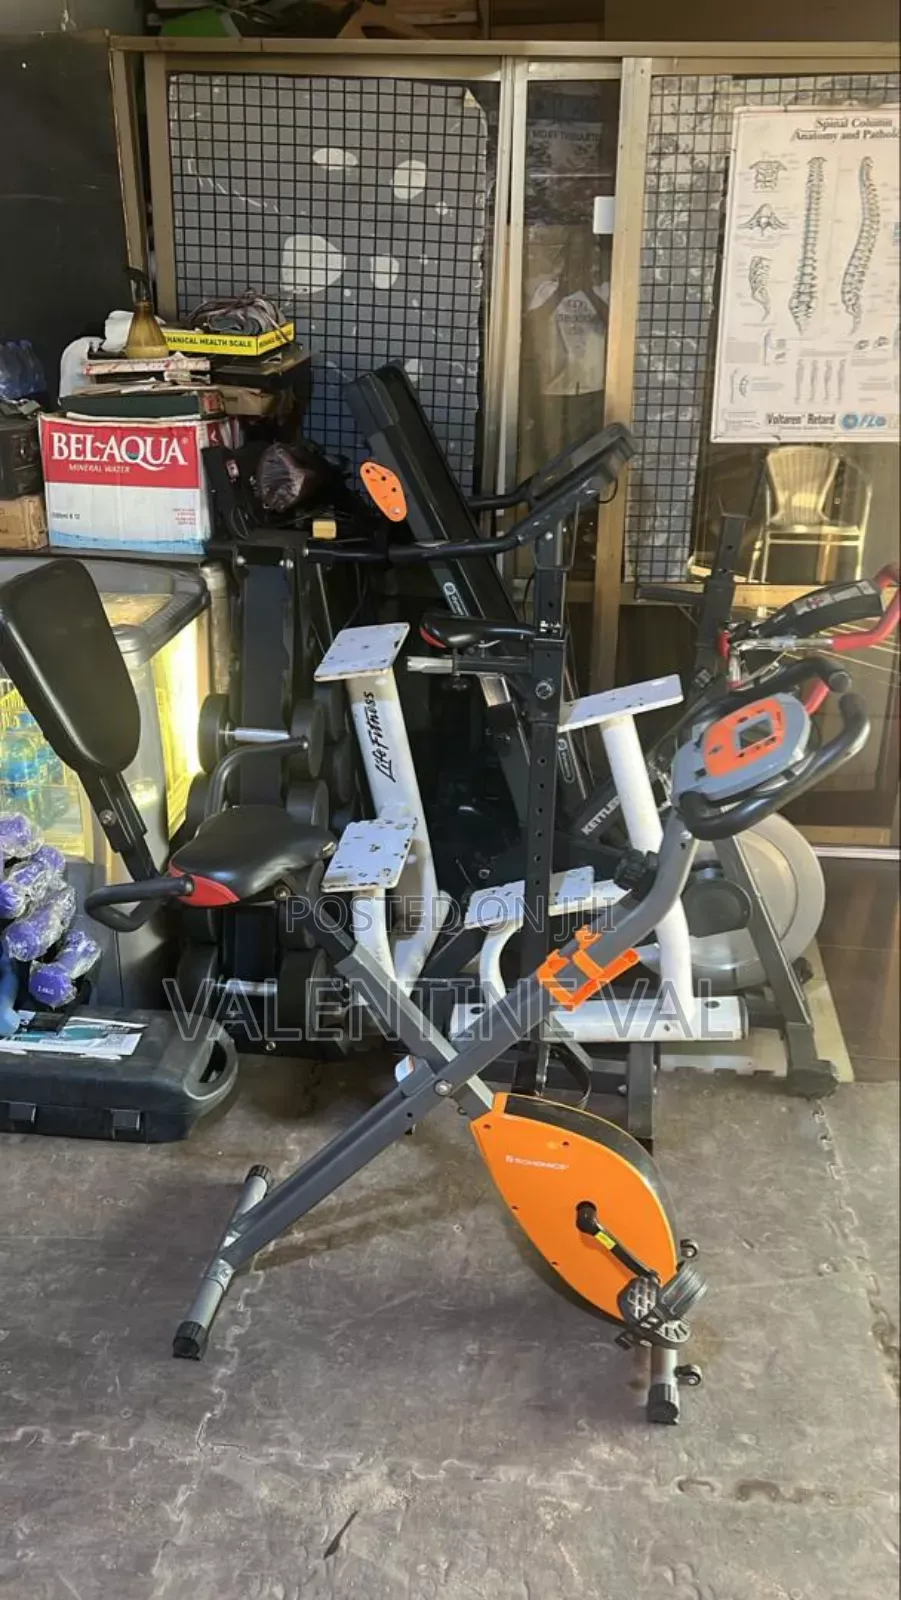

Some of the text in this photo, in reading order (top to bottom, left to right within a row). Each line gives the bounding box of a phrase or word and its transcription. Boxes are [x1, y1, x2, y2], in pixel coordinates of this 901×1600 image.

[815, 117, 893, 131] Spinal Column
[795, 129, 836, 142] Anatomy
[841, 129, 860, 140] and
[200, 337, 227, 347] HEALTH
[229, 338, 253, 348] SCALE
[807, 412, 836, 425] Retard
[68, 463, 131, 474] MINERAL WATER
